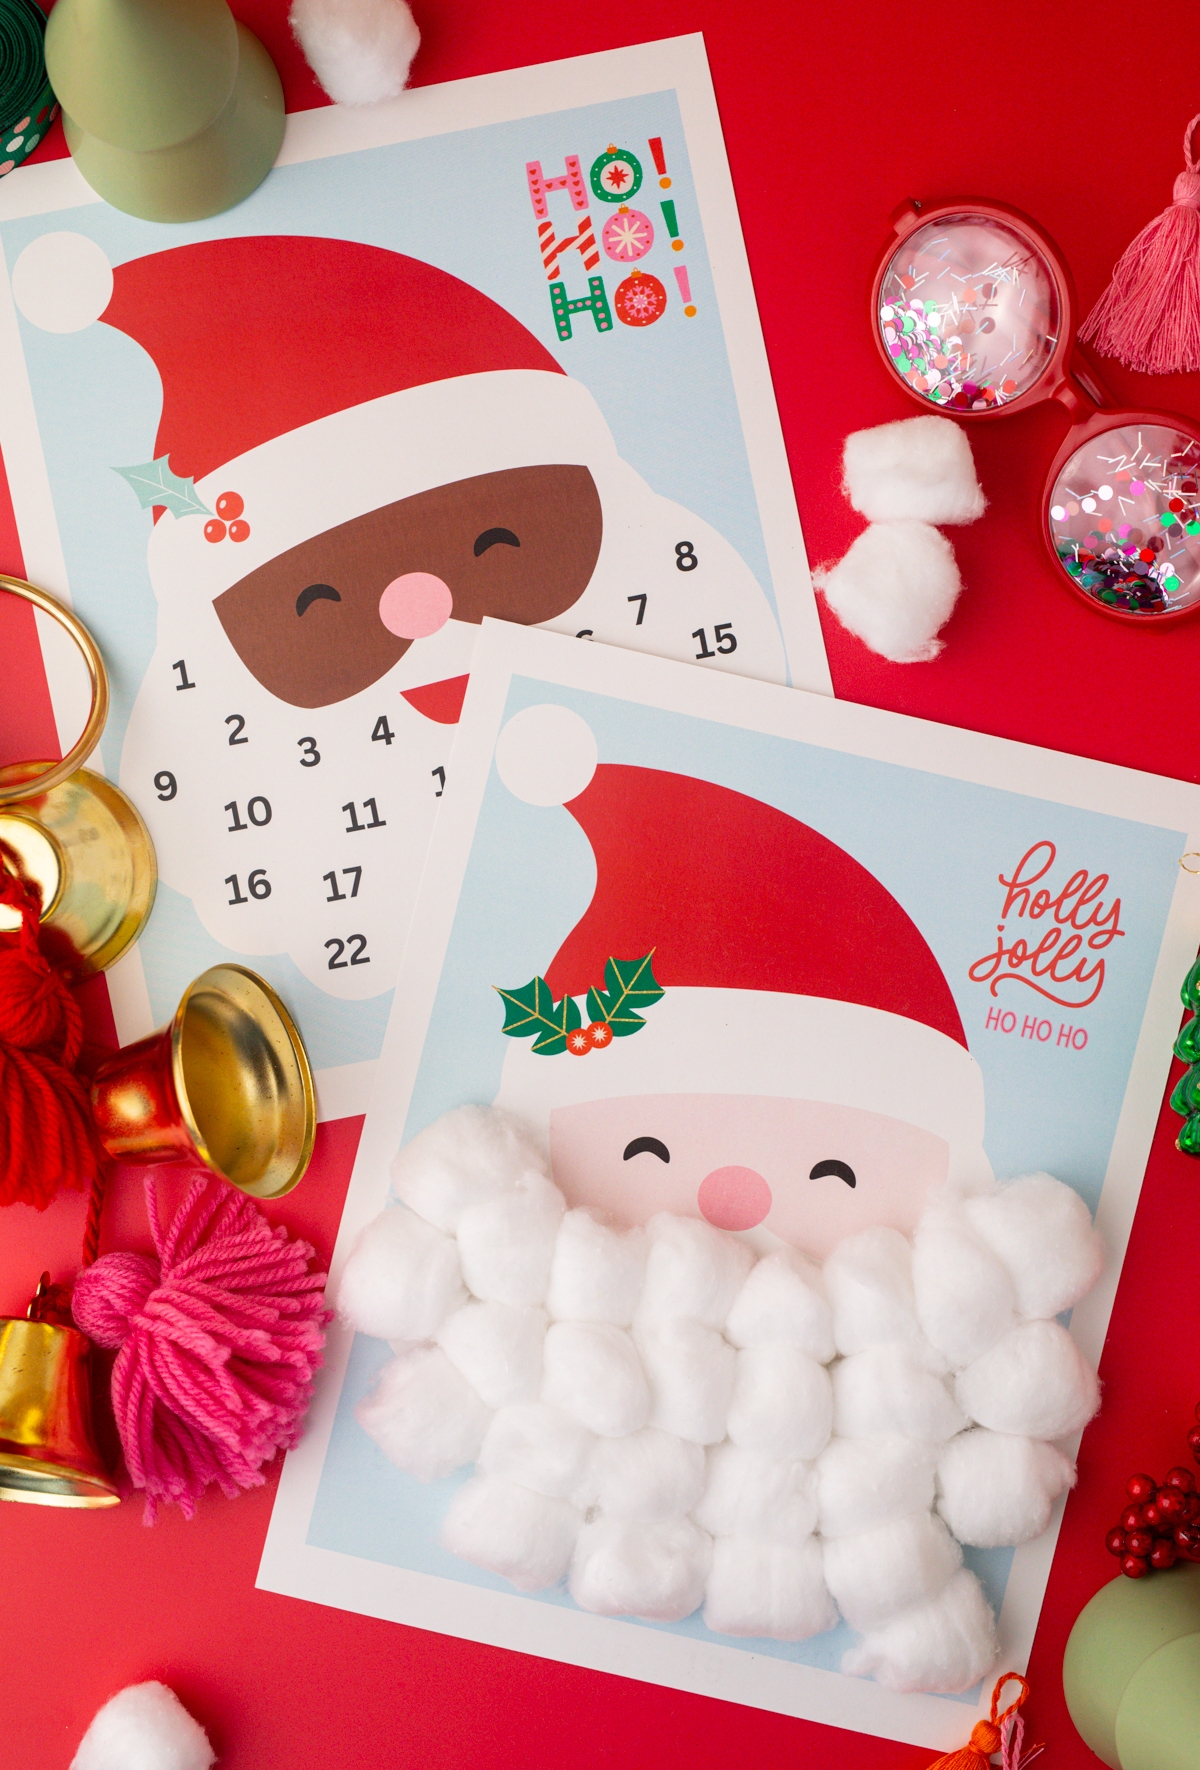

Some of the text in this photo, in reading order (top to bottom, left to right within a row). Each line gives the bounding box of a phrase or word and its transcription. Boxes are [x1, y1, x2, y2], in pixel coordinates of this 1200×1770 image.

[674, 541, 698, 571] 8
[627, 593, 648, 626] 7
[691, 622, 738, 660] 15
[172, 659, 196, 691] 1
[224, 714, 249, 746] 2
[371, 715, 395, 746] 4
[297, 736, 321, 768] 3
[153, 770, 178, 802] 9
[224, 796, 273, 832] 10
[341, 797, 387, 833] 11
[224, 868, 272, 906] 16
[322, 865, 363, 903] 17
[998, 840, 1126, 950] holly
[323, 933, 371, 971] 22
[968, 924, 1105, 1009] jolly
[985, 1006, 1088, 1051] HO HO HO
